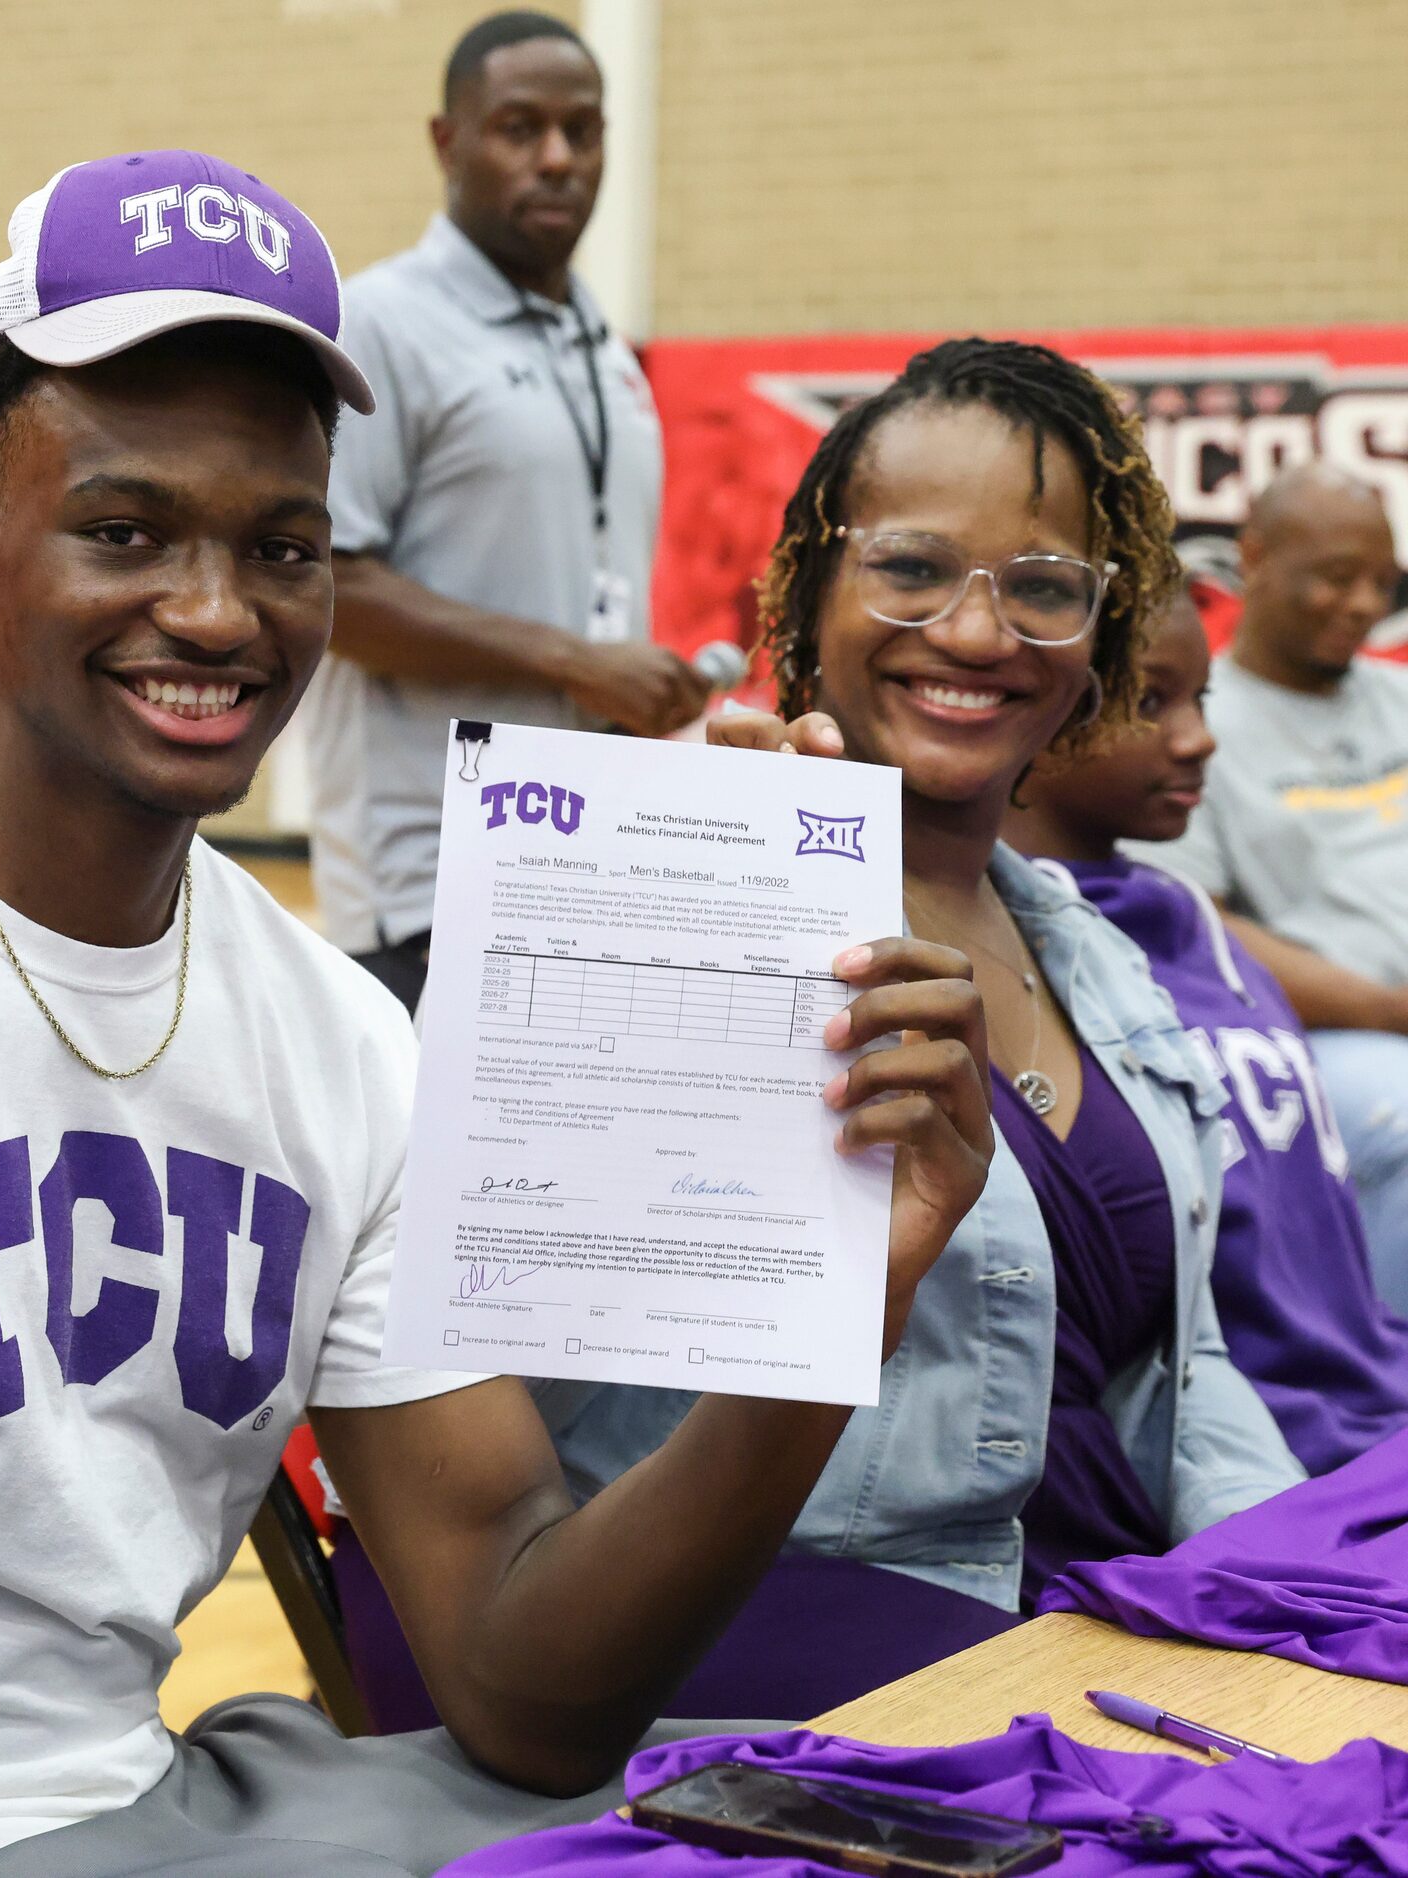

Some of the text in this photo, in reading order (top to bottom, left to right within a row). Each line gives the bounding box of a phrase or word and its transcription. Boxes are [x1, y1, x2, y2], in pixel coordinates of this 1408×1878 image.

[120, 183, 291, 275] TCU
[480, 781, 585, 836] TCU
[635, 811, 749, 832] Texas Christian University
[616, 823, 765, 848] Athletics Financial Aid Agreement
[495, 853, 789, 888] Name Isaiah Manning Sport Men's Basketball Issued 11/9/2022
[494, 932, 527, 942] Academic
[546, 937, 570, 945] Tuition
[511, 944, 531, 954] Term
[483, 953, 510, 964] 2023-24
[600, 951, 621, 960] Room
[650, 955, 670, 964] Board
[743, 953, 789, 964] Miscellaneous
[699, 959, 719, 968] Books
[483, 965, 511, 975] 2024-25
[750, 964, 782, 975] Expenses
[805, 969, 840, 979] Percentag
[481, 977, 510, 988] 2025-26
[798, 980, 817, 990] 100%
[480, 989, 509, 999] 2026-27
[797, 992, 814, 1001] 100%
[479, 1001, 508, 1011] 2027-28
[795, 1003, 814, 1013] 100%
[794, 1015, 812, 1024] 100%
[793, 1026, 810, 1035] 100%
[478, 1034, 597, 1051] International insurance paid via SAF?
[471, 1094, 488, 1102] Prior
[497, 1096, 521, 1106] signing
[521, 1097, 533, 1105] the
[533, 1099, 564, 1109] contract,
[564, 1101, 586, 1111] please
[609, 1104, 623, 1113] you
[622, 1105, 639, 1113] have
[640, 1106, 655, 1115] read
[655, 1107, 668, 1116] the
[668, 1108, 698, 1119] following
[698, 1111, 741, 1121] attachments:
[499, 1106, 520, 1115] Terms
[520, 1107, 533, 1116] and
[534, 1108, 569, 1119] Conditions
[577, 1112, 614, 1123] Agreement
[497, 1115, 512, 1124] TCU
[512, 1115, 552, 1128] Department
[560, 1120, 590, 1130] Athletics
[590, 1122, 608, 1131] Rules
[467, 1133, 517, 1145] Recommended
[654, 1147, 687, 1158] Approved
[459, 1194, 488, 1203] Director
[496, 1196, 526, 1207] Athletics
[534, 1199, 564, 1209] designee
[646, 1206, 673, 1216] Director
[681, 1208, 722, 1220] Scholarships
[723, 1212, 736, 1220] and
[737, 1213, 763, 1223] Student
[764, 1215, 794, 1225] Financial
[793, 1218, 806, 1226] Aid
[466, 1224, 491, 1234] signing
[503, 1227, 523, 1235] name
[523, 1228, 545, 1237] below
[549, 1229, 593, 1241] acknowledge
[593, 1232, 607, 1240] that
[612, 1234, 629, 1242] have
[629, 1235, 647, 1244] read,
[647, 1236, 688, 1247] understand,
[688, 1239, 702, 1247] and
[702, 1241, 725, 1250] accept
[726, 1242, 738, 1250] the
[738, 1243, 779, 1254] educational
[780, 1247, 802, 1256] award
[803, 1249, 824, 1257] under
[448, 1299, 533, 1314] Student-Athlete Signature
[588, 1308, 605, 1317] Date
[645, 1312, 668, 1322] Parent
[668, 1314, 700, 1325] Signature
[709, 1318, 736, 1327] student
[744, 1321, 765, 1330] under
[766, 1323, 777, 1332] 18)
[461, 1335, 490, 1344] Increase
[498, 1337, 524, 1348] original
[524, 1339, 545, 1348] award
[582, 1343, 613, 1354] Decrease
[621, 1346, 647, 1356] original
[648, 1348, 669, 1357] award
[704, 1354, 753, 1366] Renegotiation
[761, 1359, 788, 1369] original
[789, 1361, 811, 1370] award
